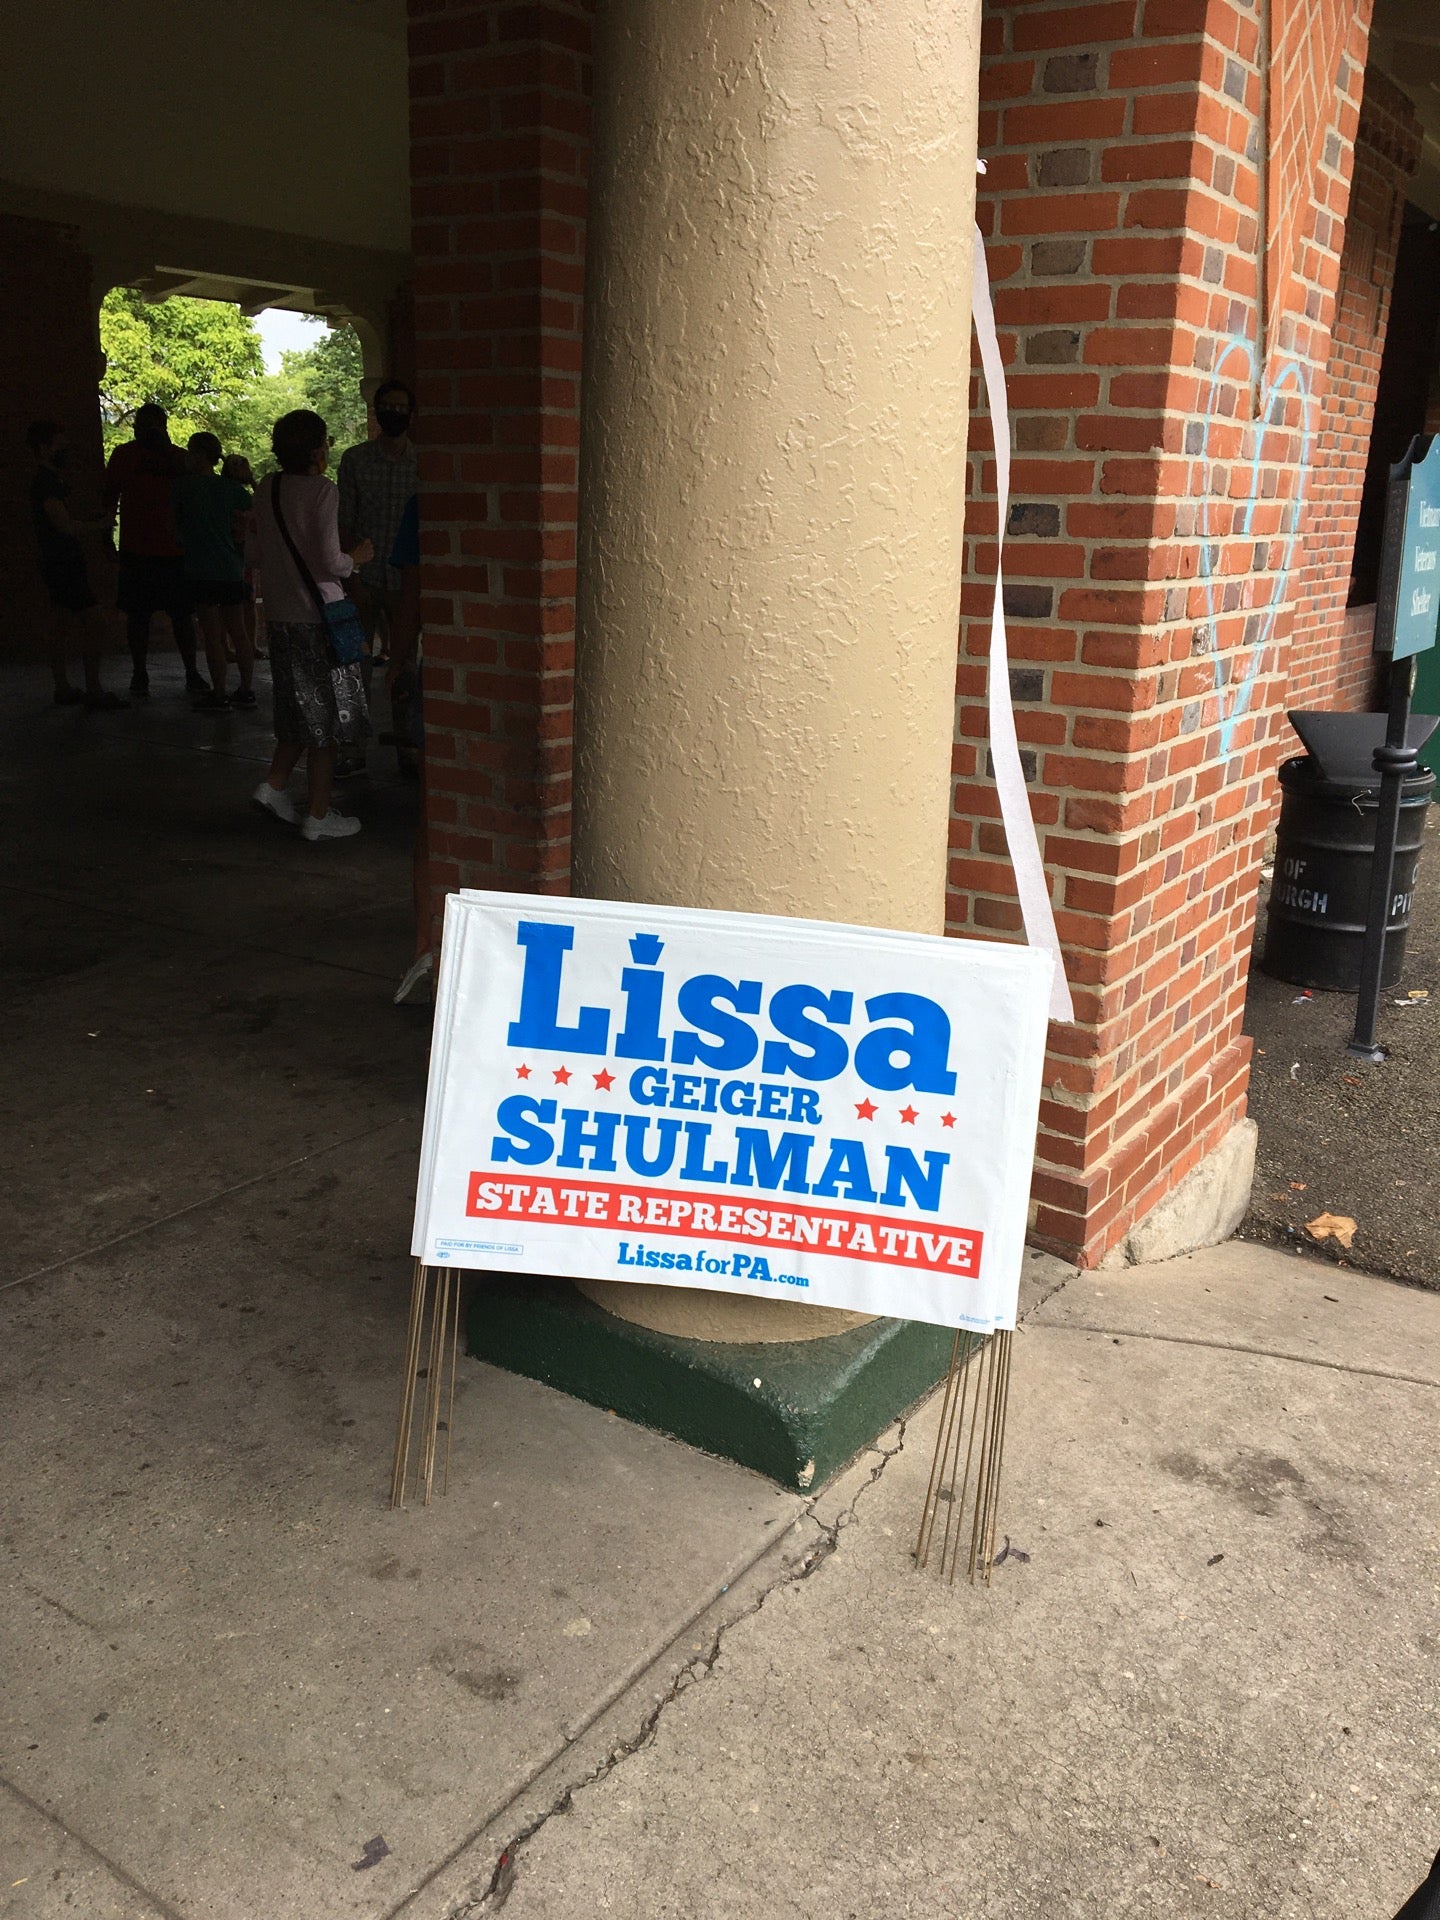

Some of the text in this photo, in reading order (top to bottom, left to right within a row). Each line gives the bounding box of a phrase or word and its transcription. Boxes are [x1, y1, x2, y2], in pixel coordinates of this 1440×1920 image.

[1284, 857, 1307, 880] OF
[507, 921, 957, 1096] Lissa
[629, 1066, 822, 1125] GEIGER
[491, 1095, 950, 1211] SHULMAN
[477, 1181, 975, 1269] STATE REPRESENTATIVE
